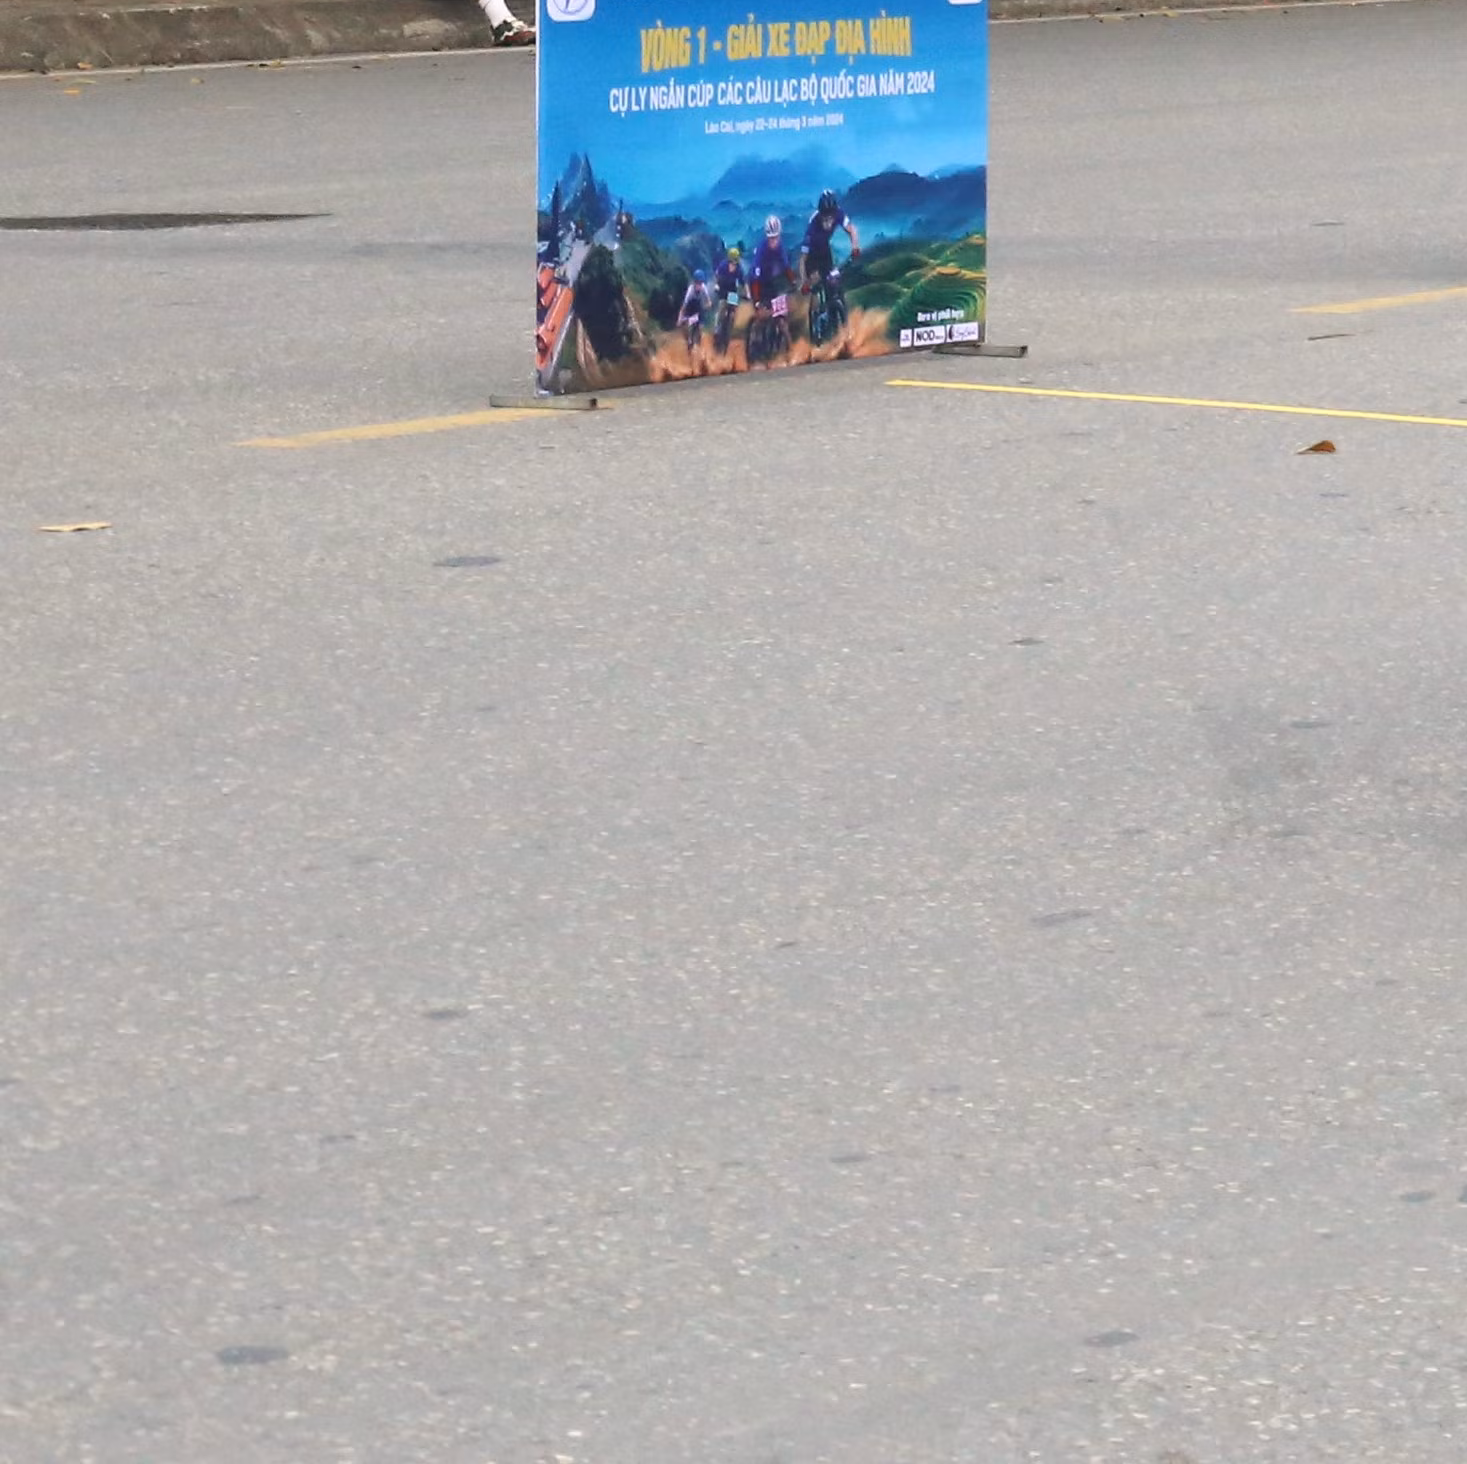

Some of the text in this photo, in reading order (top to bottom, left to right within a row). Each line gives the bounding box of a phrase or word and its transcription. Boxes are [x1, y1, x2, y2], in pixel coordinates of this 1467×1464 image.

[640, 19, 692, 73] VÒNG
[697, 25, 707, 65] 1
[727, 12, 763, 61] GIẢI
[767, 22, 791, 57] XE
[795, 20, 831, 65] ĐẠP
[835, 19, 866, 65] ĐỊA
[869, 9, 913, 57] HÌNH
[609, 68, 935, 118] CỰ LY NGẮN CÚP CÁC CÂU LẠC BỘ QUỐC GIA NĂM 2024
